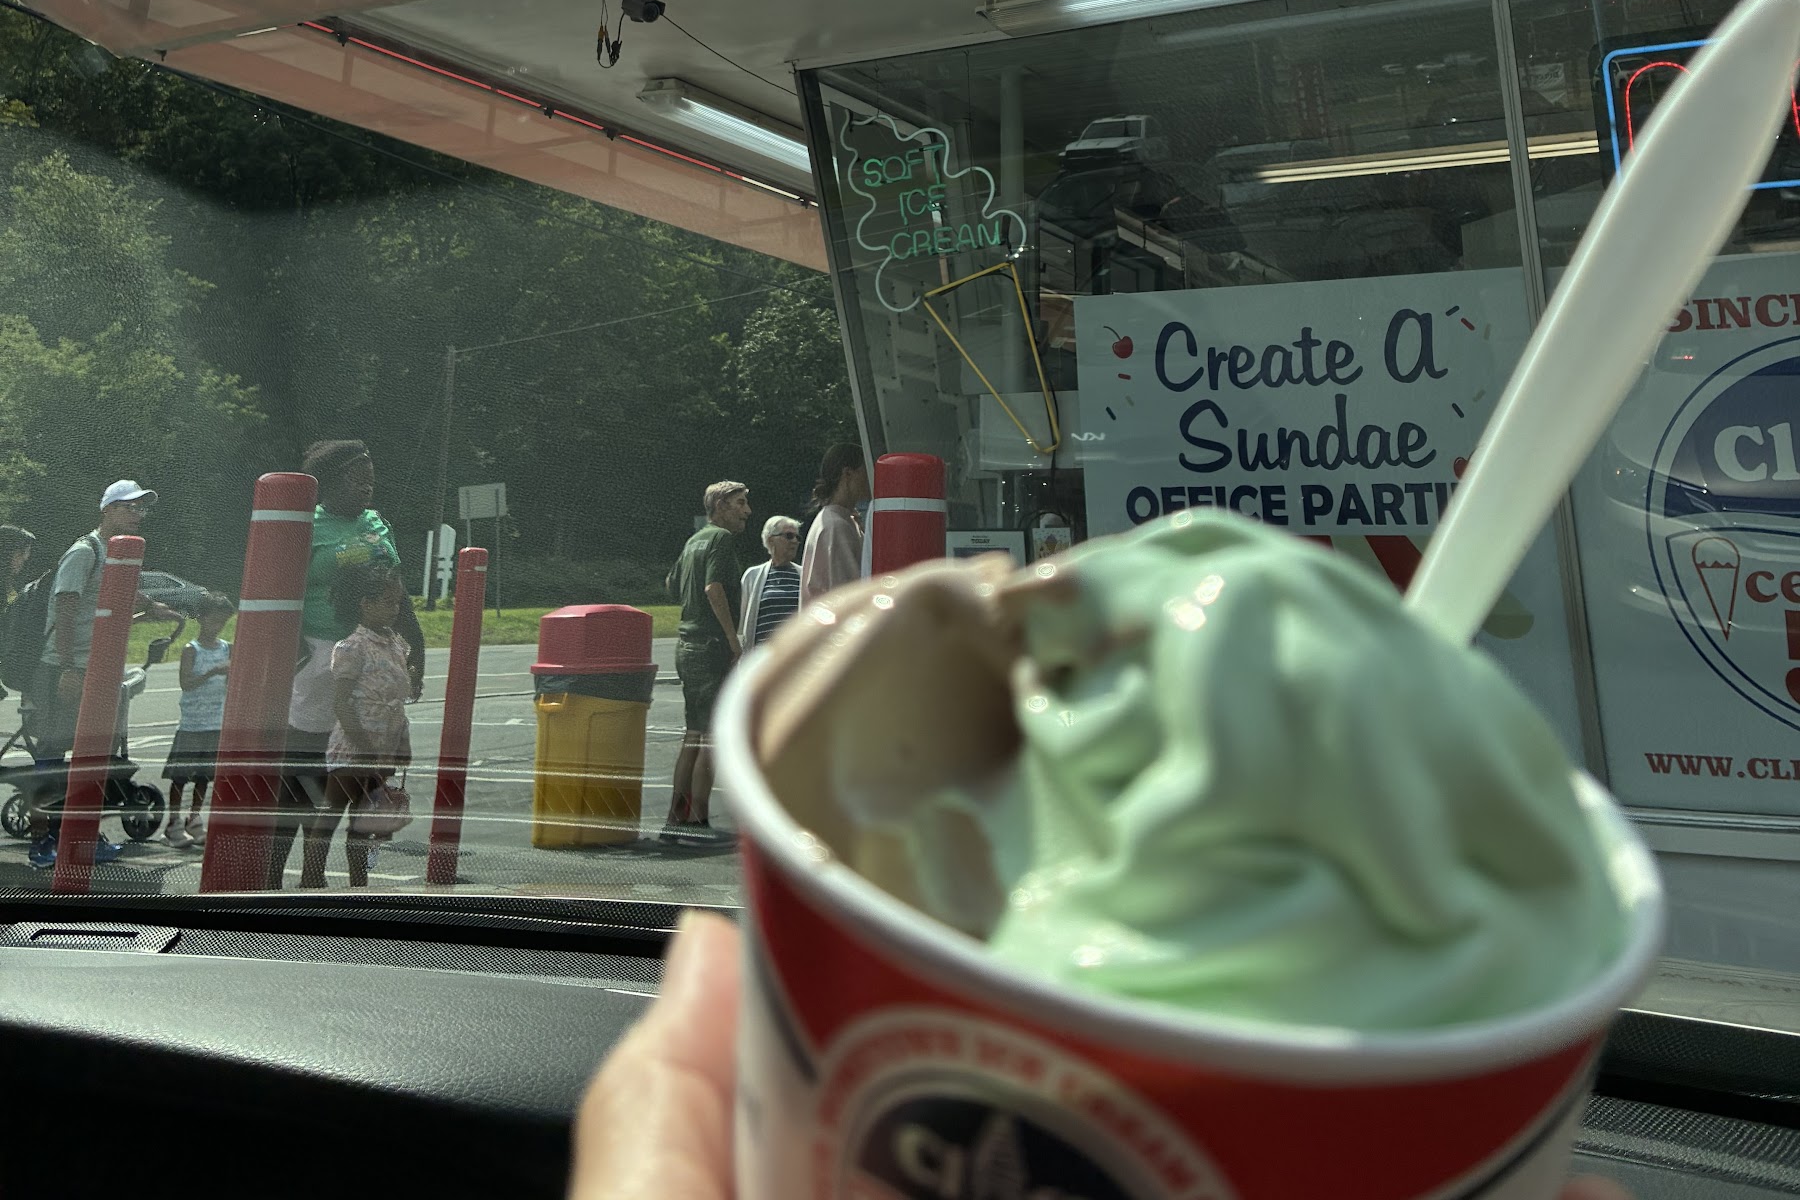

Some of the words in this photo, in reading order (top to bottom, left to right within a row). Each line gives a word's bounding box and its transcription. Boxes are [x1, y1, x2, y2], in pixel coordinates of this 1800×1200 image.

[863, 143, 945, 187] SOFT
[899, 183, 948, 226] ICE
[890, 220, 1001, 260] CREAM
[1155, 320, 1363, 393] Create
[1178, 393, 1437, 474] Sundae
[1300, 482, 1460, 527] PARTI
